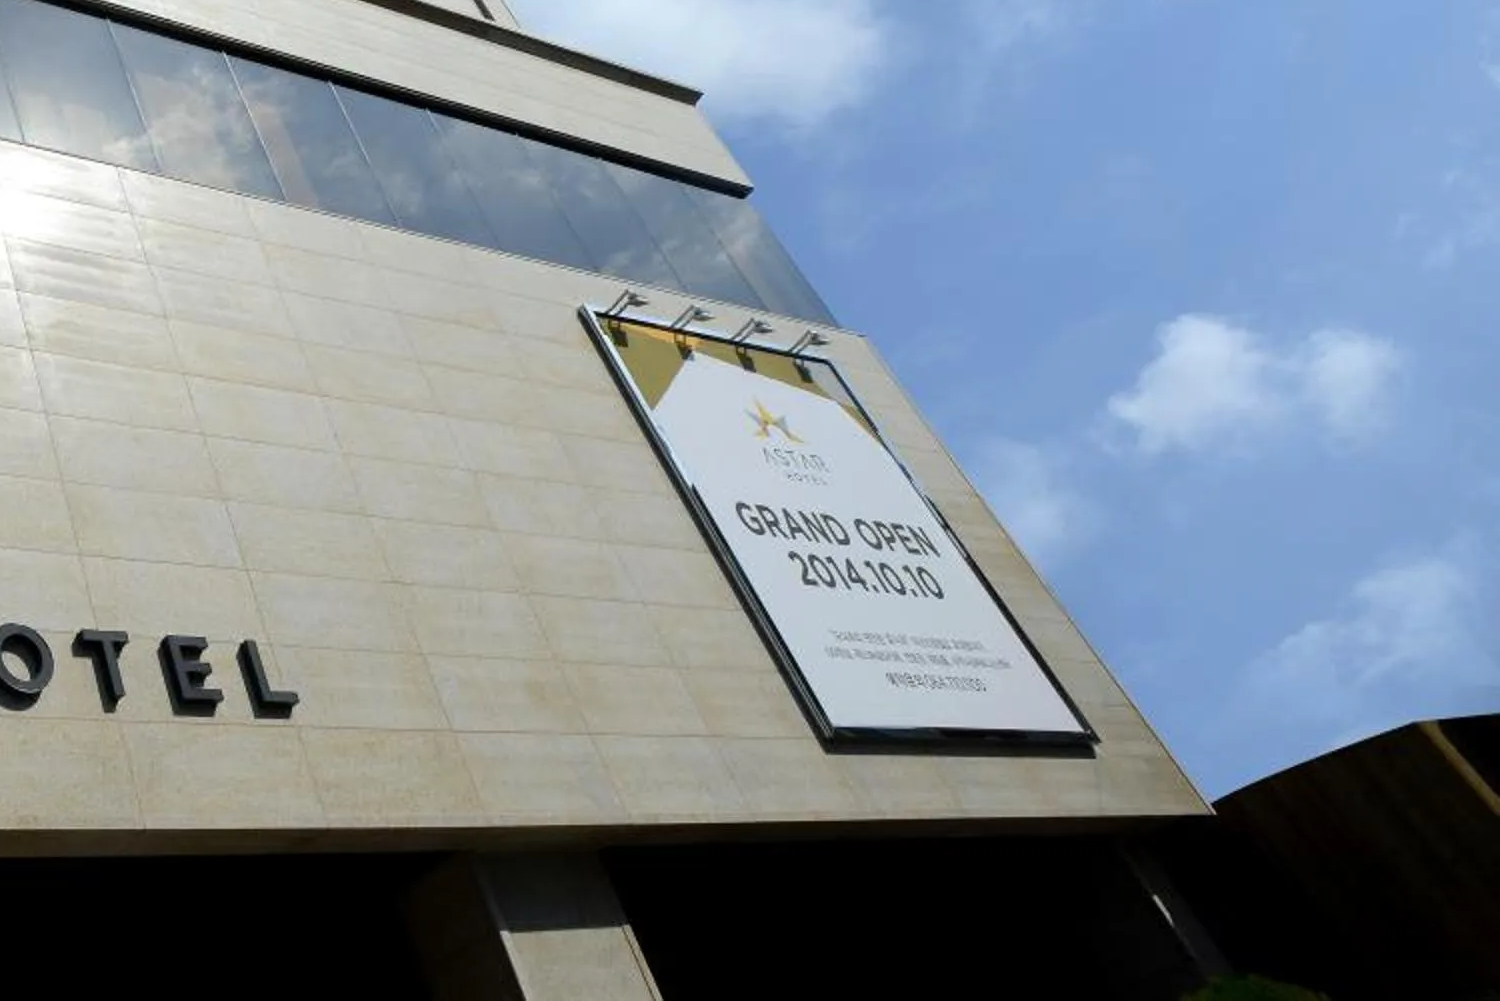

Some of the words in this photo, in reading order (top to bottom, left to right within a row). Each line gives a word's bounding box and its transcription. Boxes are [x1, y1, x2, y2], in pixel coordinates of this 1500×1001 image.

[762, 447, 829, 472] ASTAR
[735, 502, 850, 546] GRAND
[853, 518, 940, 558] OPEN
[788, 551, 945, 600] 2014.10.10
